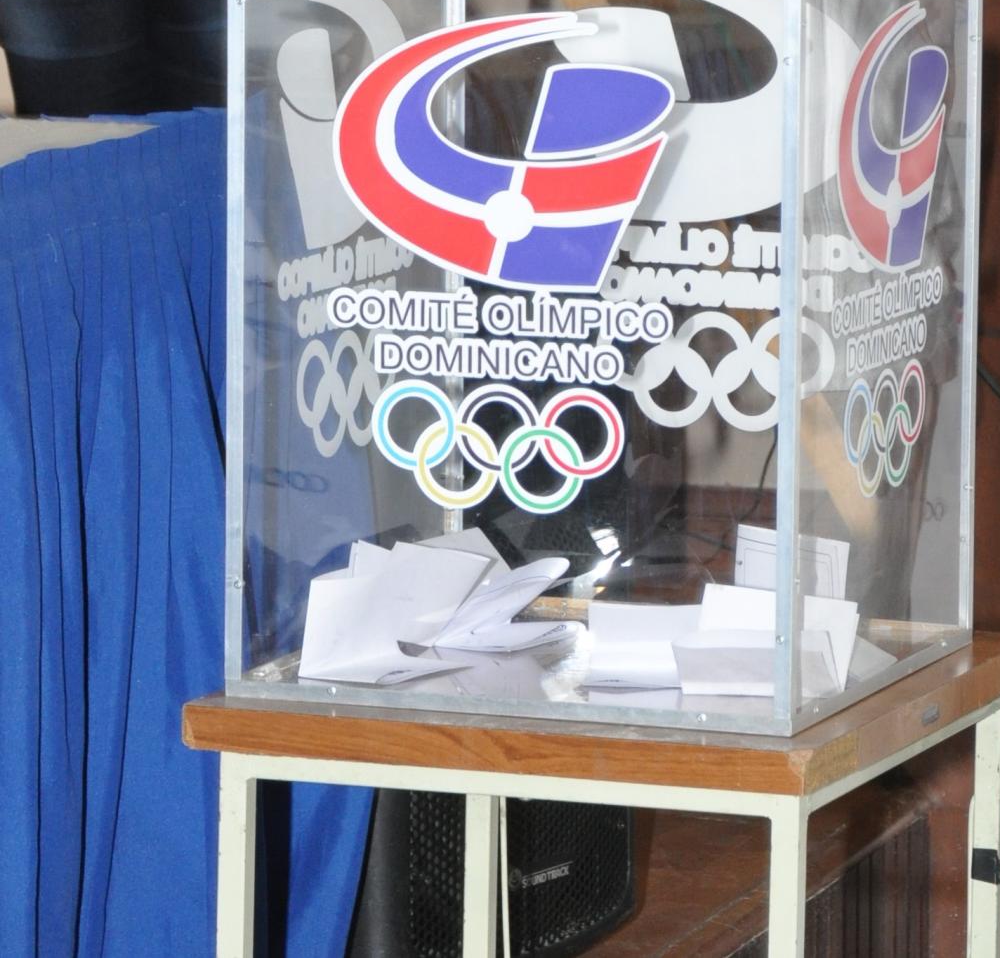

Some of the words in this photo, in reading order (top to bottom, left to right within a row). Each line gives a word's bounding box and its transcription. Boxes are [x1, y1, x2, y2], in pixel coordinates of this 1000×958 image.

[332, 293, 475, 330] COMITÉ
[487, 295, 670, 340] OLÍMPICO
[832, 284, 881, 338] COMITÉ
[884, 270, 941, 320] OLÍMPICO
[379, 340, 621, 382] DOMINICANO
[847, 317, 926, 376] DOMINICANO
